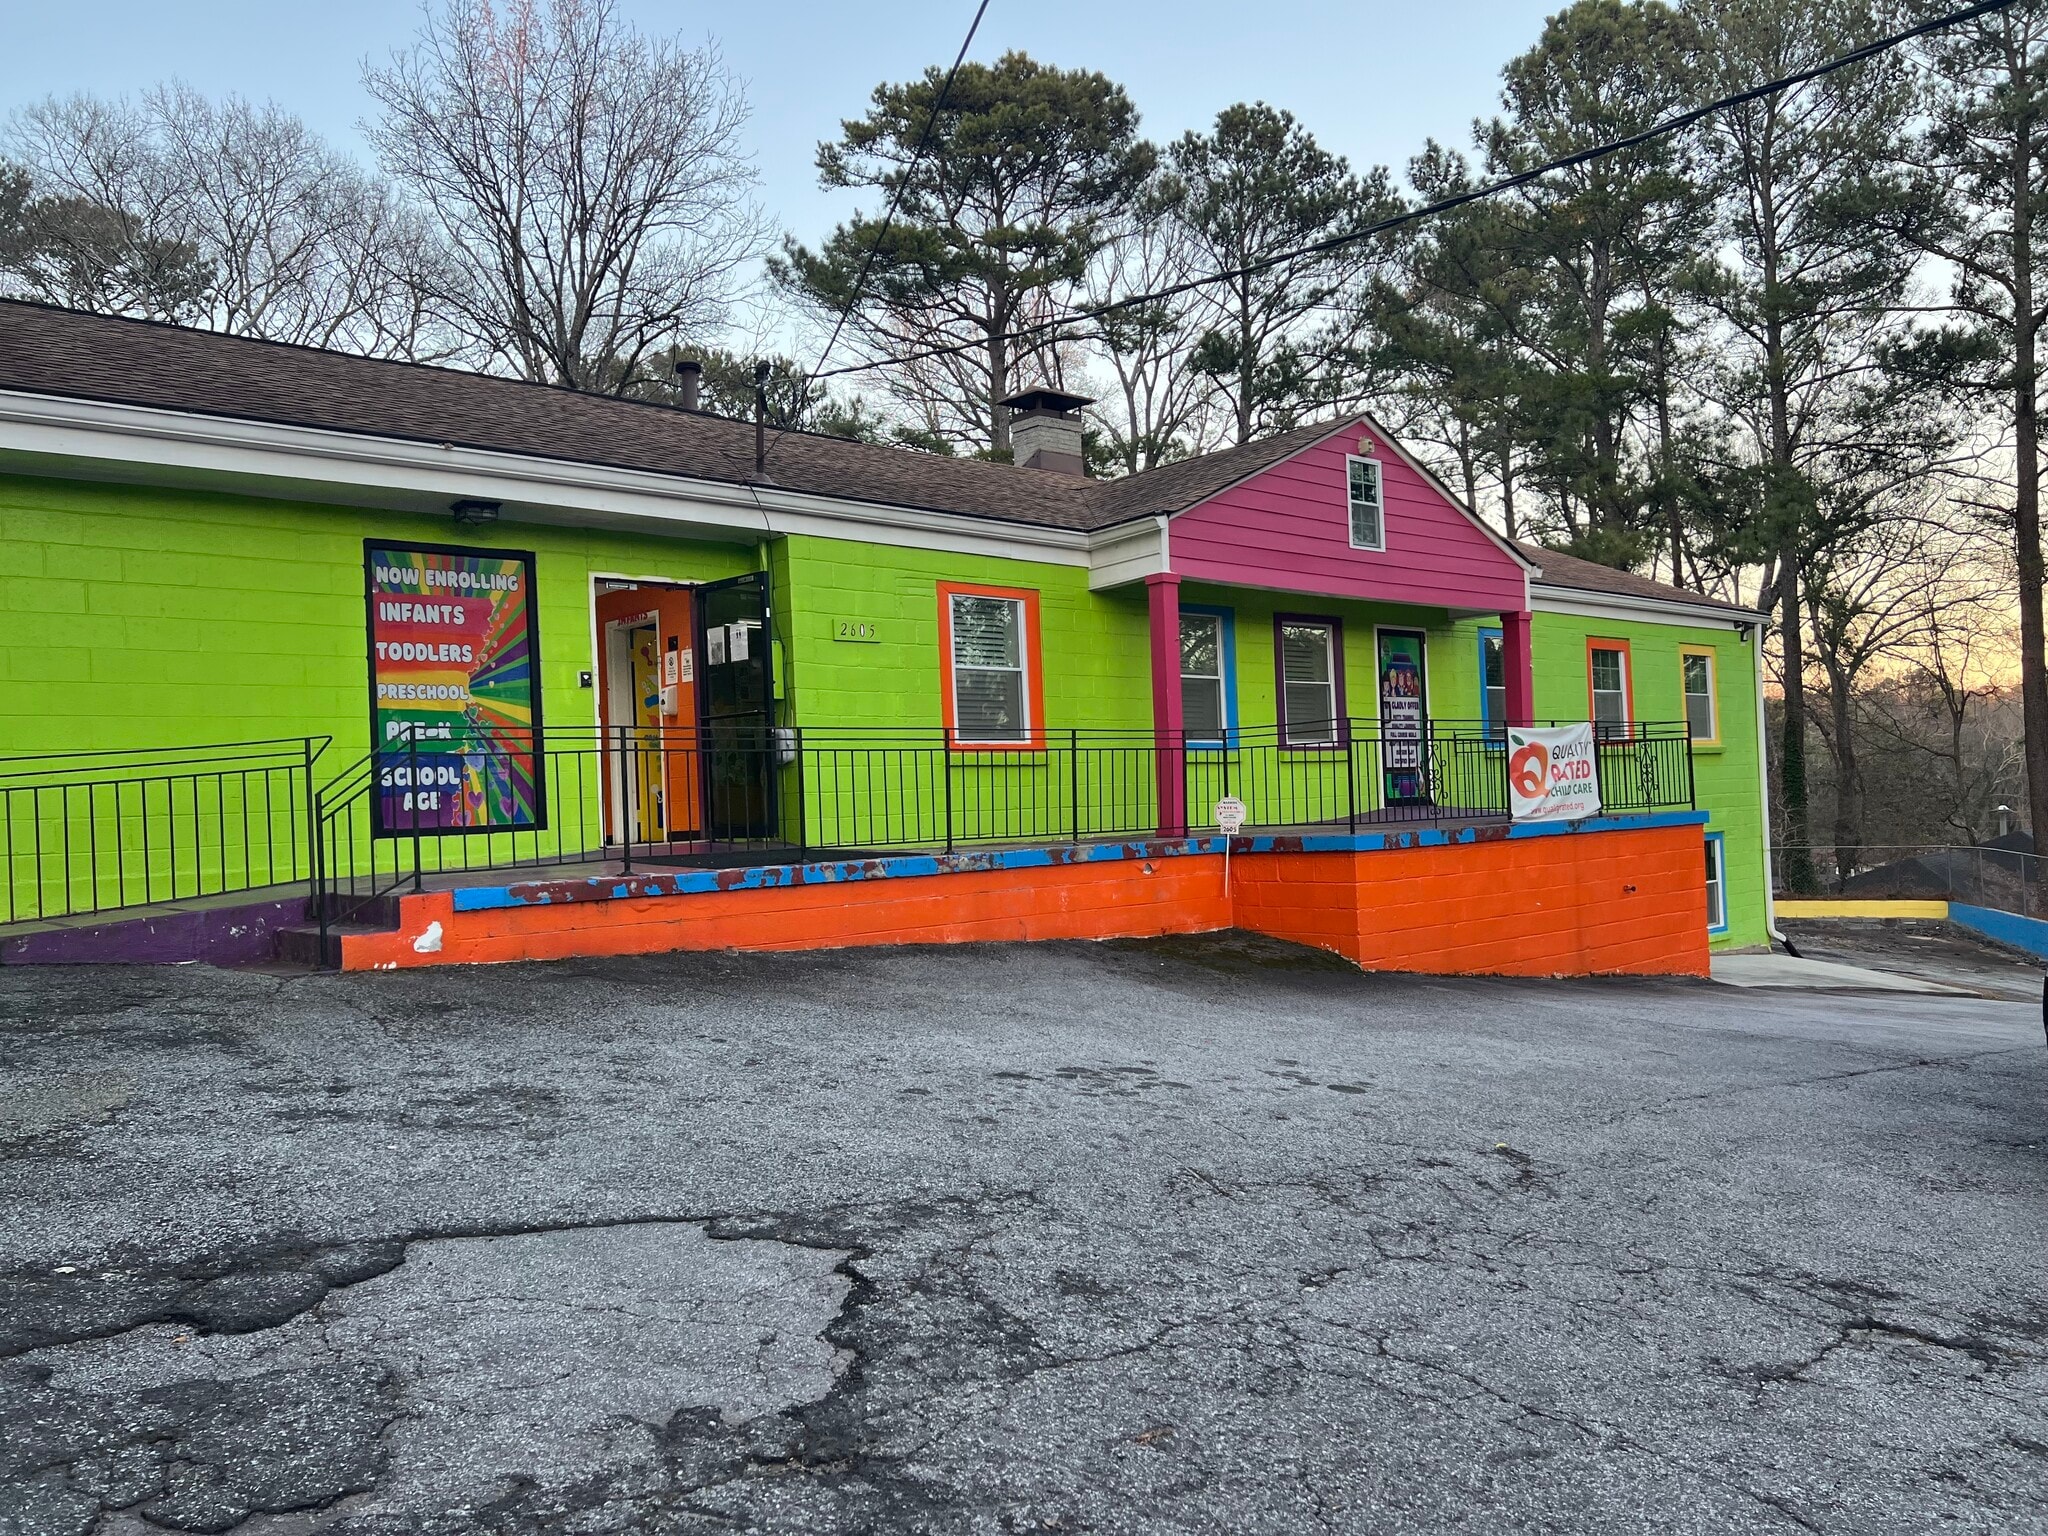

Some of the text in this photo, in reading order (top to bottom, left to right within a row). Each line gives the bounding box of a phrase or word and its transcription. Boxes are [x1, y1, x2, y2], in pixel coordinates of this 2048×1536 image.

[375, 566, 519, 592] NOW ENROLLING
[379, 602, 465, 625] INFANTS
[841, 622, 875, 639] 2605
[376, 642, 473, 663] TODDLERS
[377, 682, 470, 701] PRESCHOOL
[386, 721, 452, 742] PRE-K
[381, 766, 461, 787] SCHOOL
[1551, 760, 1591, 782] RATED
[1550, 782, 1593, 798] CHILD CARE
[403, 791, 441, 812] AGE
